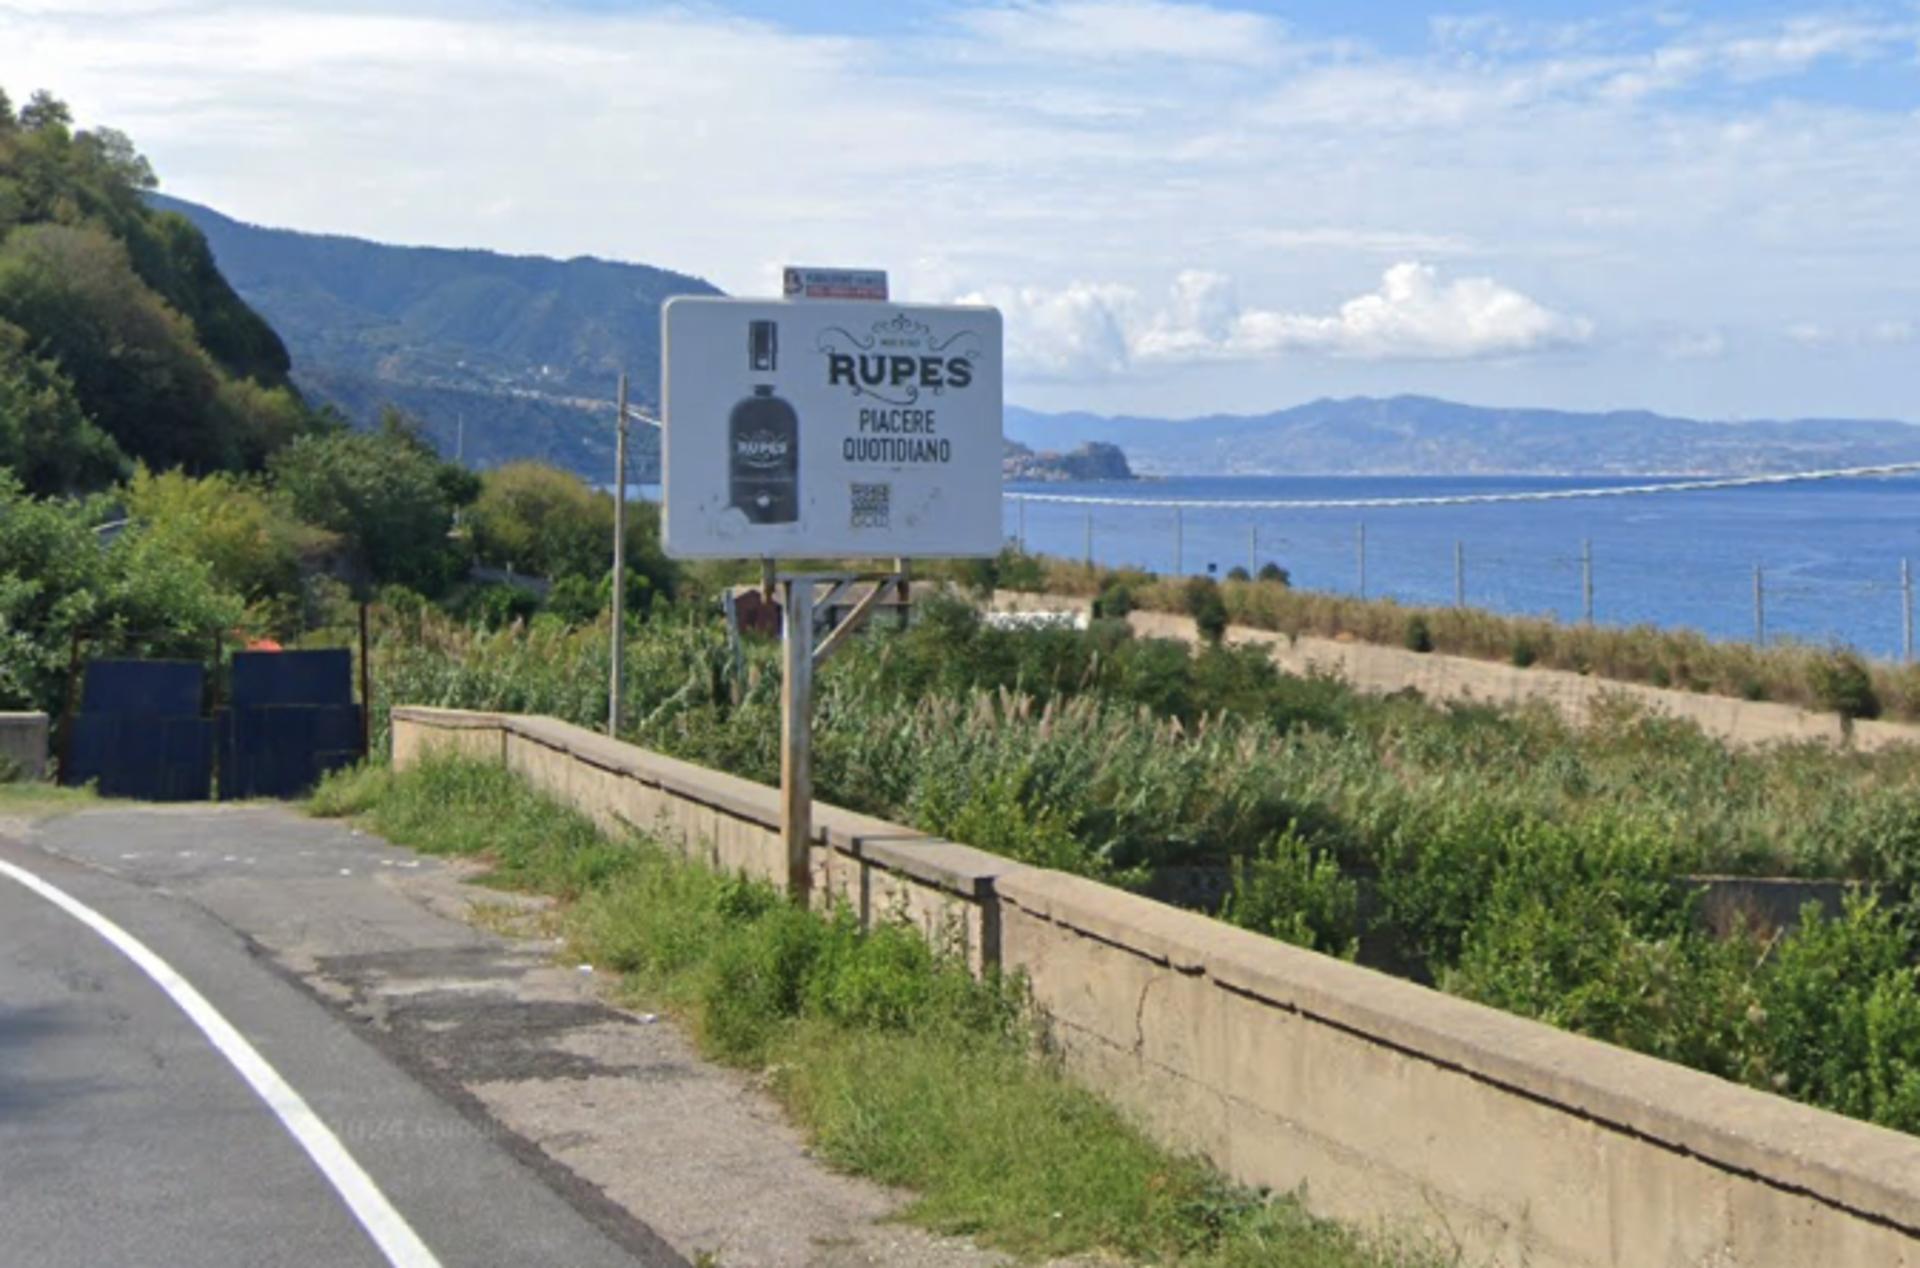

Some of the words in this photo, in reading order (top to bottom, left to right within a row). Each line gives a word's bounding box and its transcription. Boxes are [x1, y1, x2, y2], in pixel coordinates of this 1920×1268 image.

[828, 353, 973, 388] RUPES
[859, 408, 935, 433] PIACERE
[843, 437, 951, 463] QUOTIDIANO
